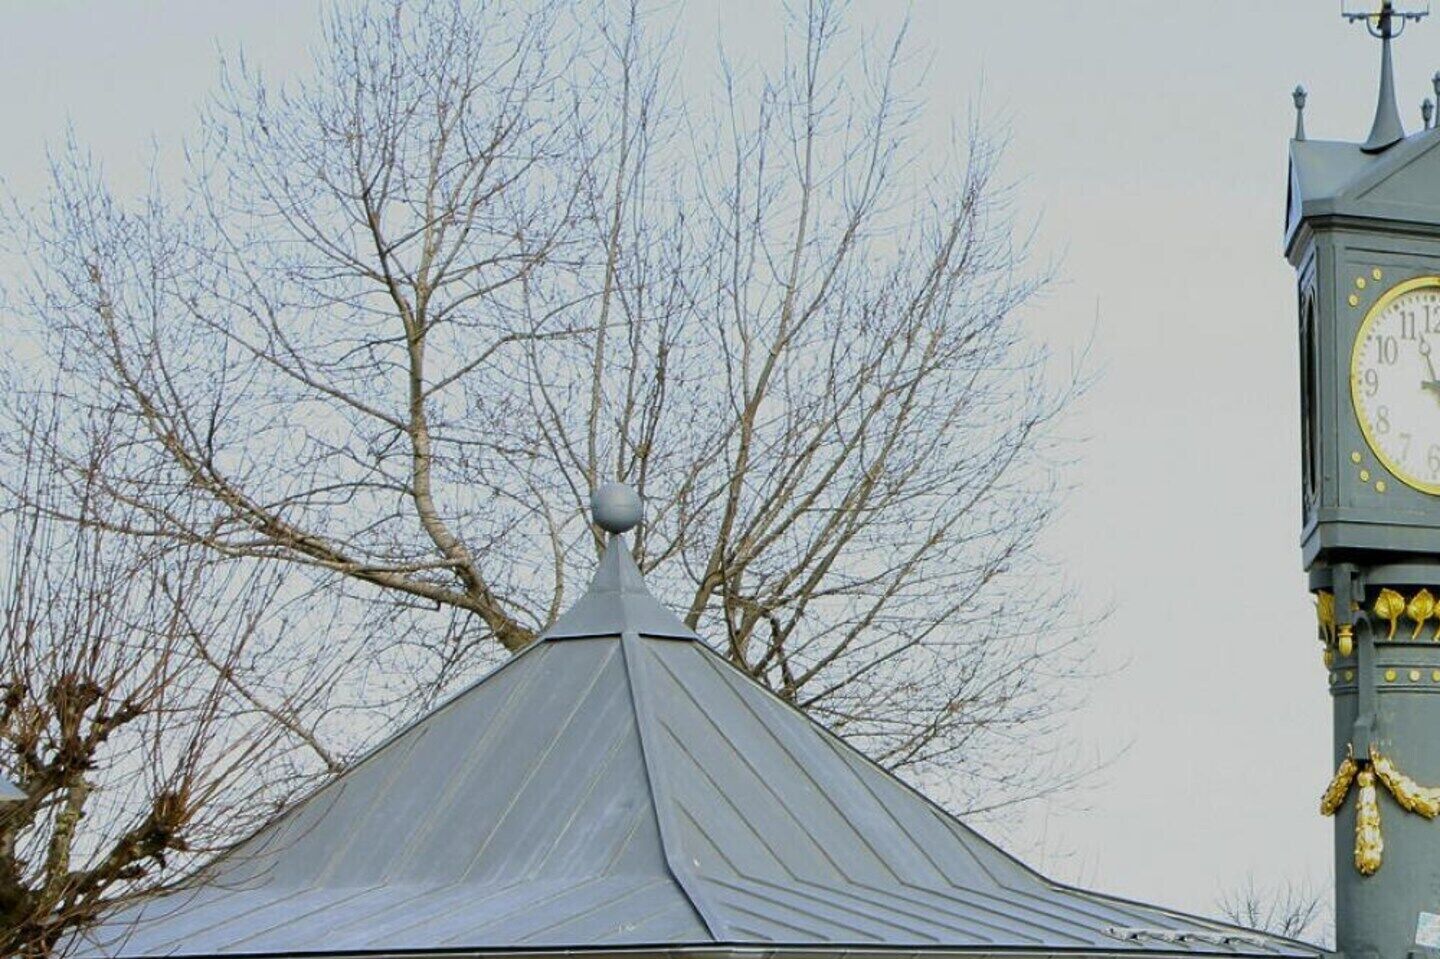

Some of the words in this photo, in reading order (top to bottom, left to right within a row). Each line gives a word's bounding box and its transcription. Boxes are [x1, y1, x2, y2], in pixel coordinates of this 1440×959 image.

[1400, 311, 1417, 341] 11
[1376, 336, 1399, 366] 10
[1365, 368, 1379, 397] 9
[1376, 405, 1390, 434] 8
[1400, 432, 1412, 461] 7
[1427, 444, 1440, 473] 6
